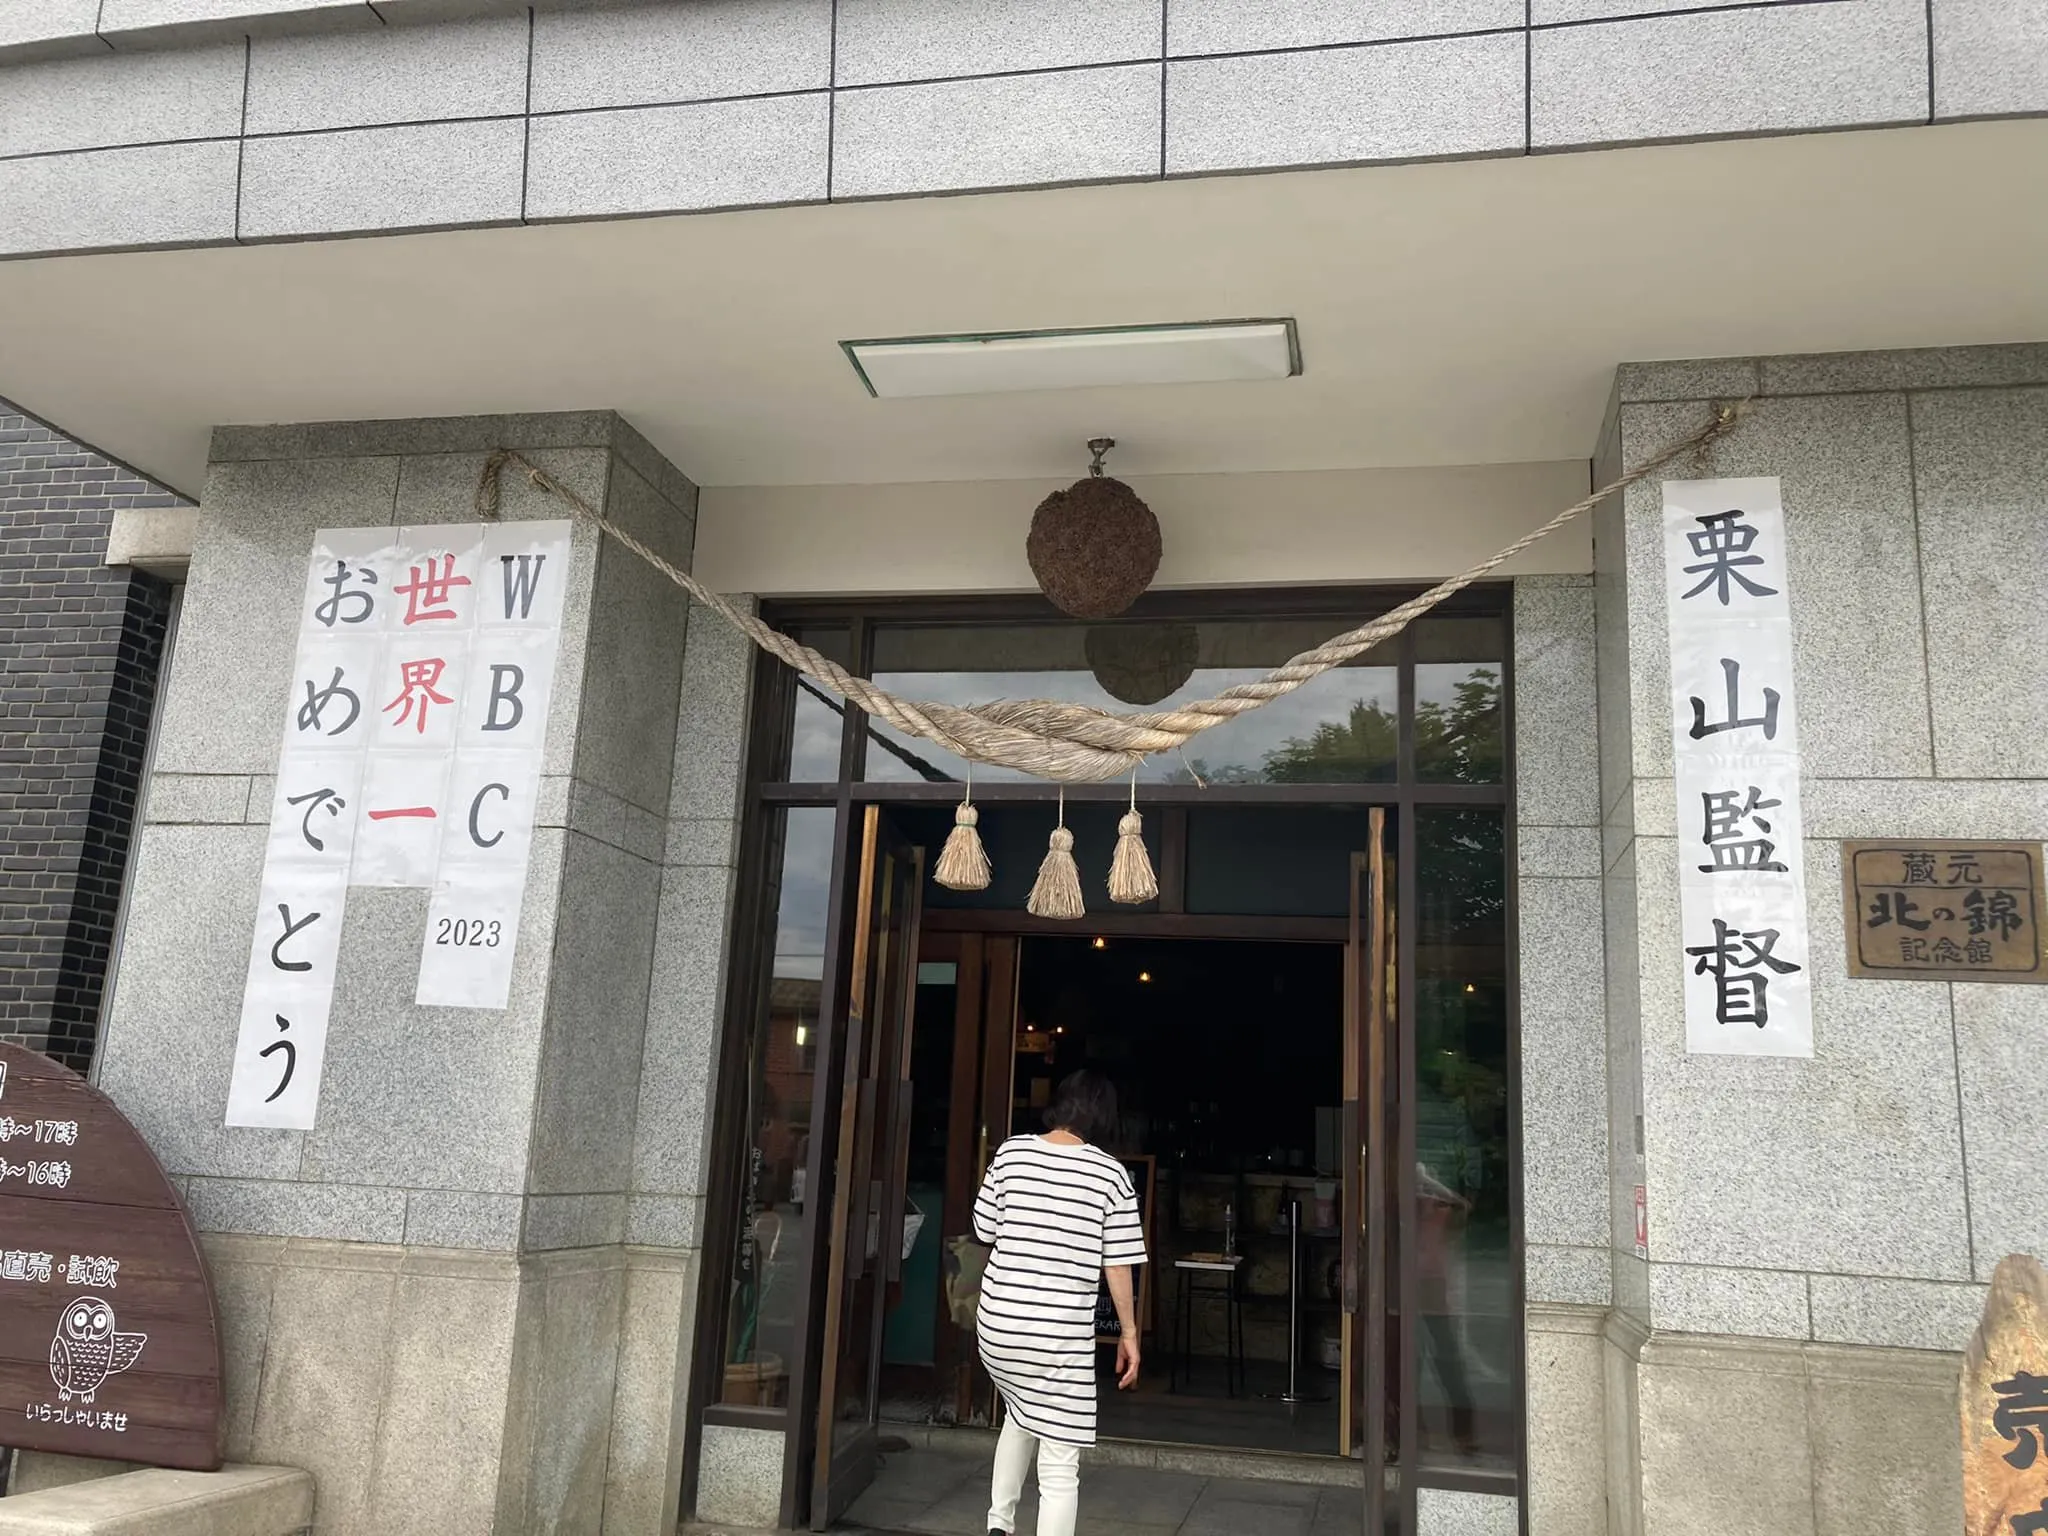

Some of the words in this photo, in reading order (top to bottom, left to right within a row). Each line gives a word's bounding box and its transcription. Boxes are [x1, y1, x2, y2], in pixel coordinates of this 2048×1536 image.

[368, 552, 472, 822] 世界一
[469, 553, 546, 849] WBC
[1681, 509, 1802, 1030] 栗山監督
[259, 558, 379, 1104] おめでとう
[1902, 853, 1983, 885] 蔵元
[435, 918, 501, 948] 2023
[1867, 888, 2024, 943] 北の錦
[1899, 936, 1993, 964] 記念館
[0, 1250, 120, 1289] 直売・試飲
[26, 1402, 129, 1433] いらっしゃいませ
